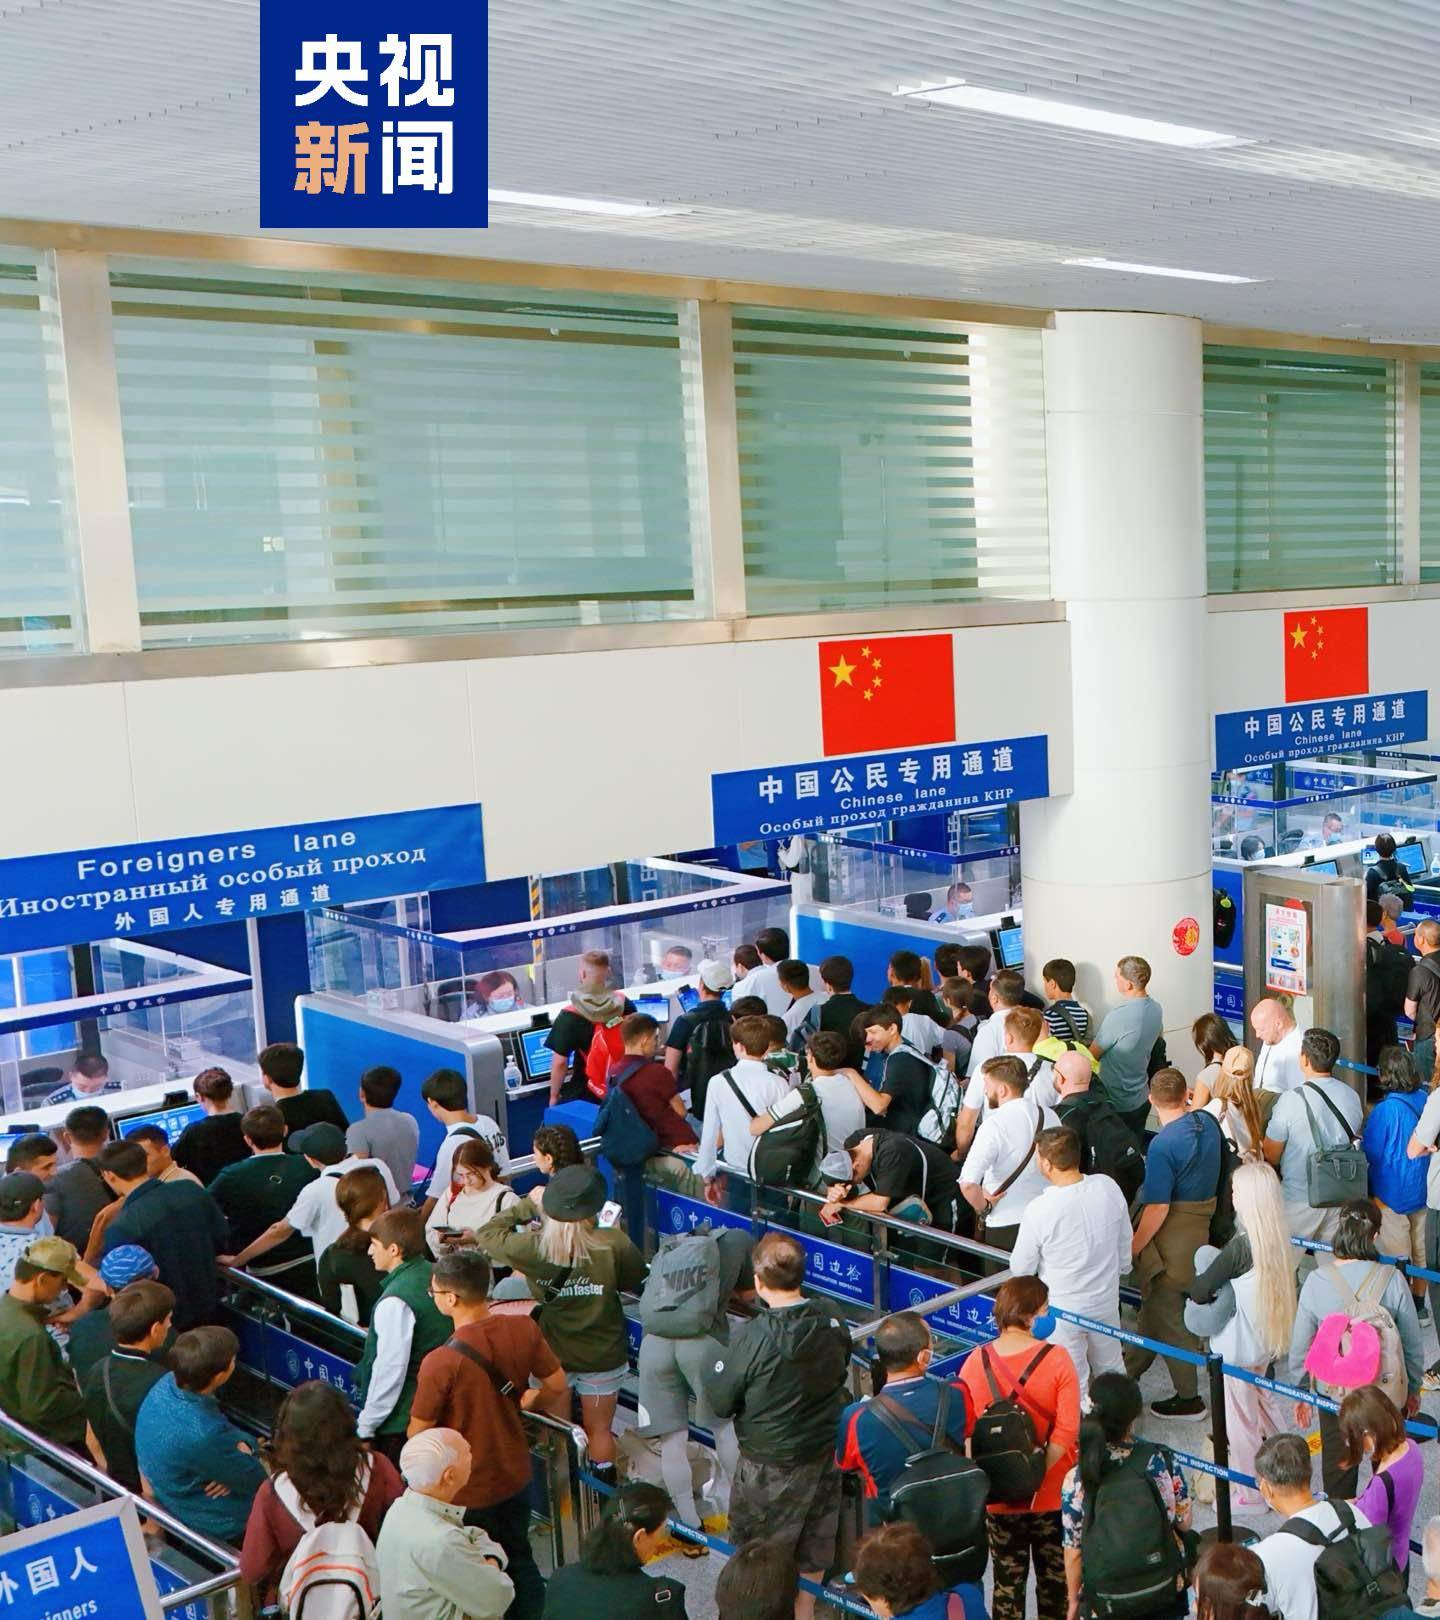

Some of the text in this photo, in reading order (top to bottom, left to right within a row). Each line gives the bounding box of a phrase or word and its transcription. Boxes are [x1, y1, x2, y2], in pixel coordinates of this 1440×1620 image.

[1244, 698, 1405, 739] 中国公民专用通道
[1244, 750, 1284, 763] Особый
[1288, 746, 1323, 758] проход
[1386, 732, 1405, 742] КНР
[1295, 729, 1362, 745] Chinese lane
[758, 746, 1014, 804] 中国公民专用通道
[759, 788, 1014, 835] Особый проход гражданина КНР
[840, 787, 946, 810] Chinese lane
[77, 831, 356, 880] Foreigners lane
[0, 848, 426, 919] Иностранный особый проход
[114, 884, 330, 931] 外国人专用通道
[662, 1265, 713, 1292] NIKE
[804, 1252, 862, 1282] 国边检
[573, 1284, 604, 1296] faster
[823, 1590, 845, 1604] CHINA
